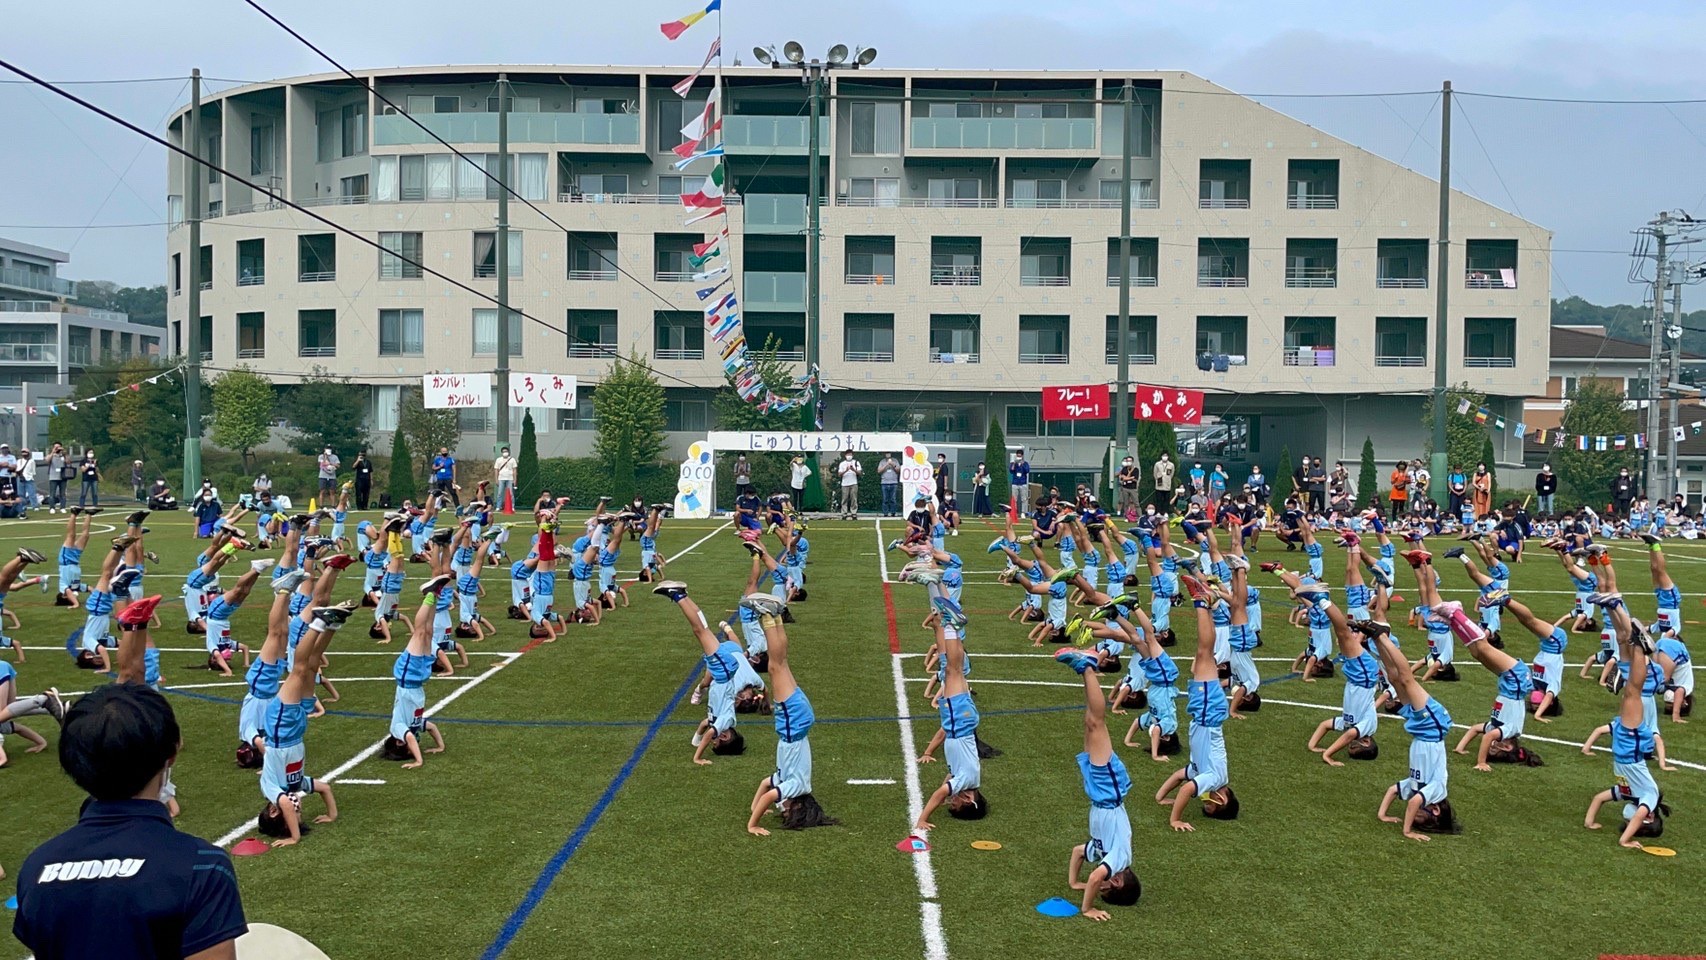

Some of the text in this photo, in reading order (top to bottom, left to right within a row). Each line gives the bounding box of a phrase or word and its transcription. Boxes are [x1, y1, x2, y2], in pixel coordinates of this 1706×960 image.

[749, 433, 871, 451] にゅうじょうもん
[38, 858, 146, 884] BUDDY
